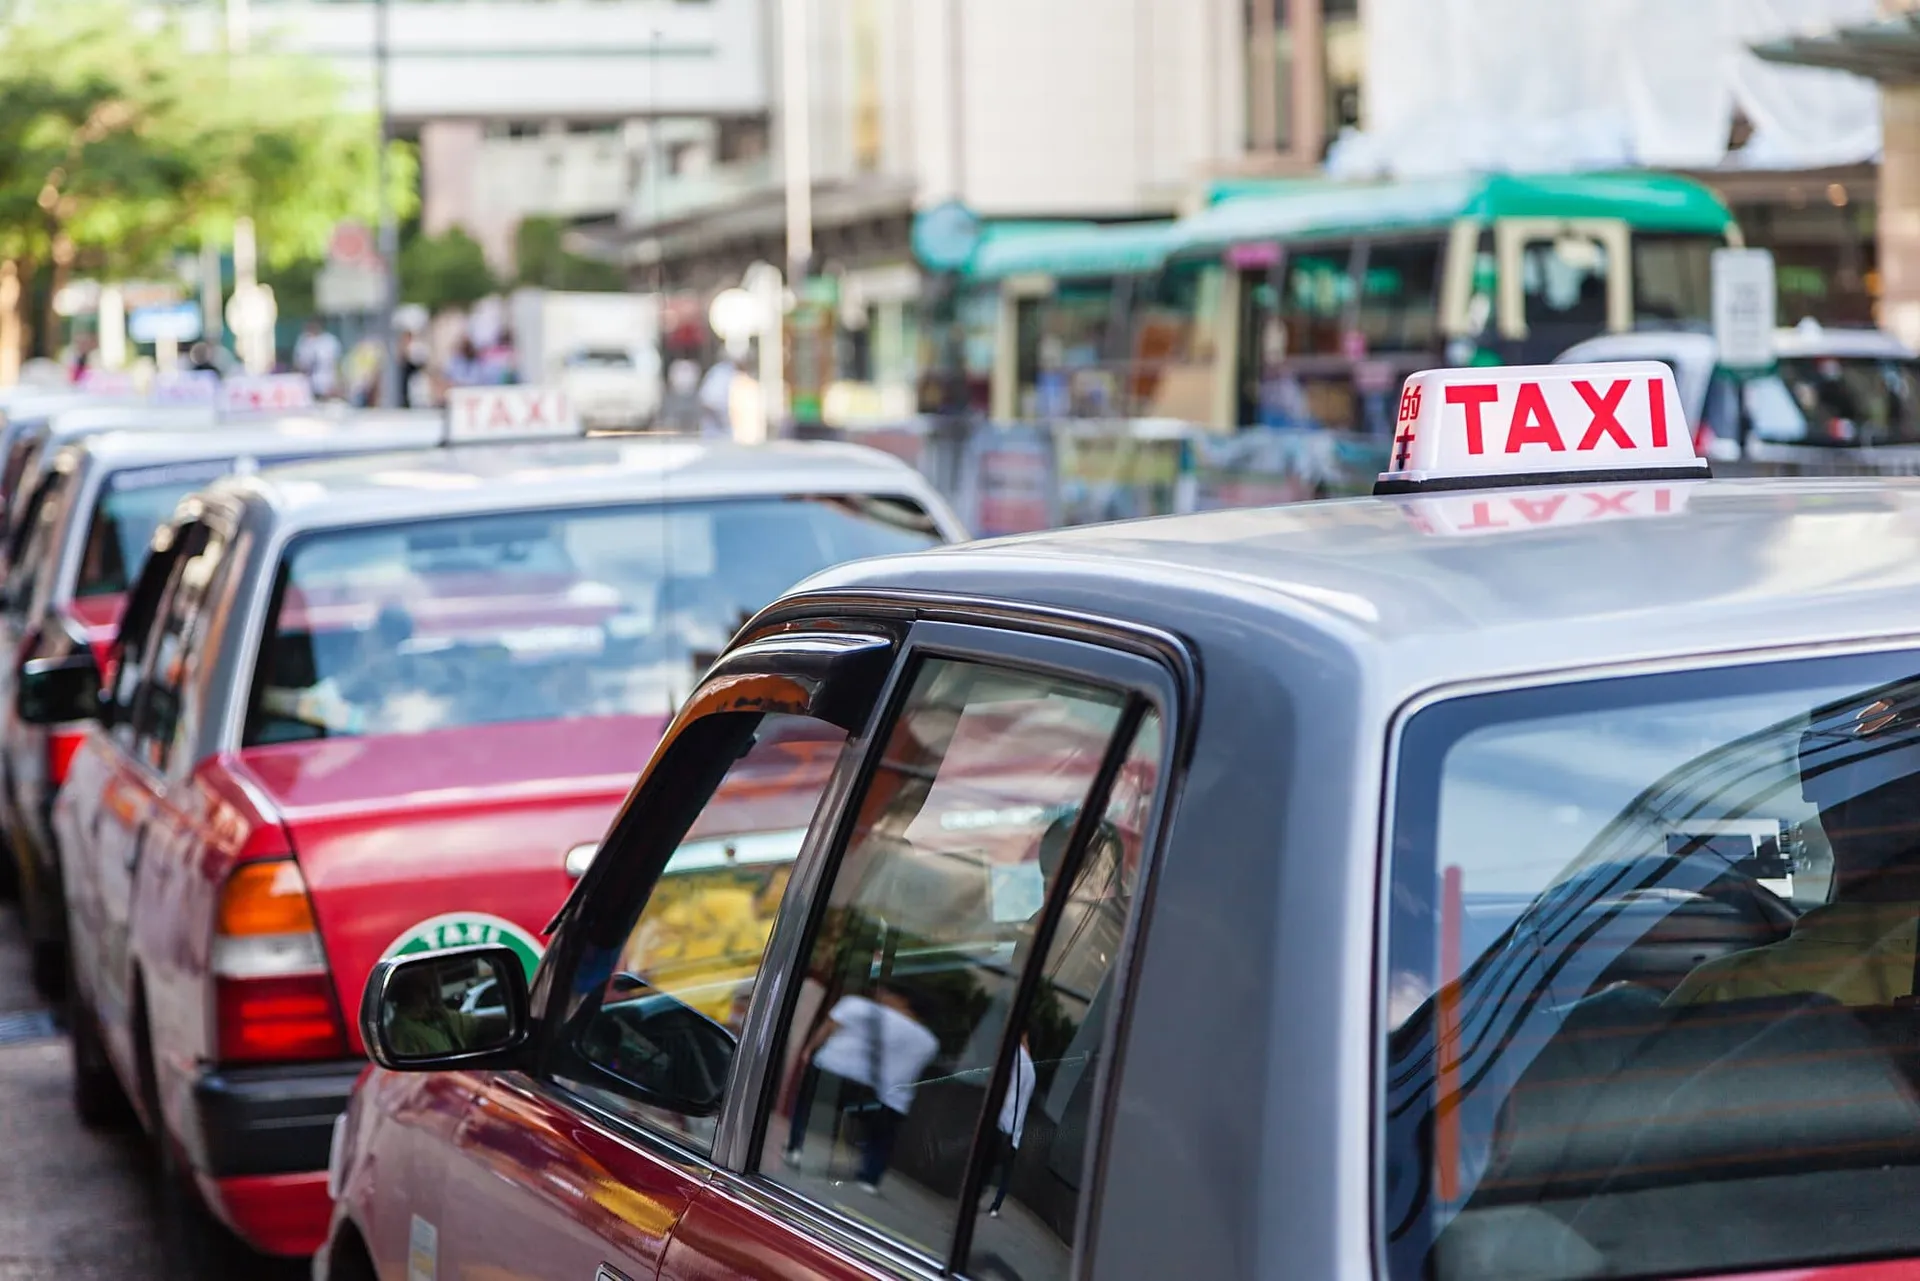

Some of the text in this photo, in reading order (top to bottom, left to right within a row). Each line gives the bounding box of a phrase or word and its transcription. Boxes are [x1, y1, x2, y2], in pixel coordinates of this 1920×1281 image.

[464, 392, 567, 430] TAXI
[1396, 386, 1421, 462] 的士
[1445, 378, 1668, 455] TAXI
